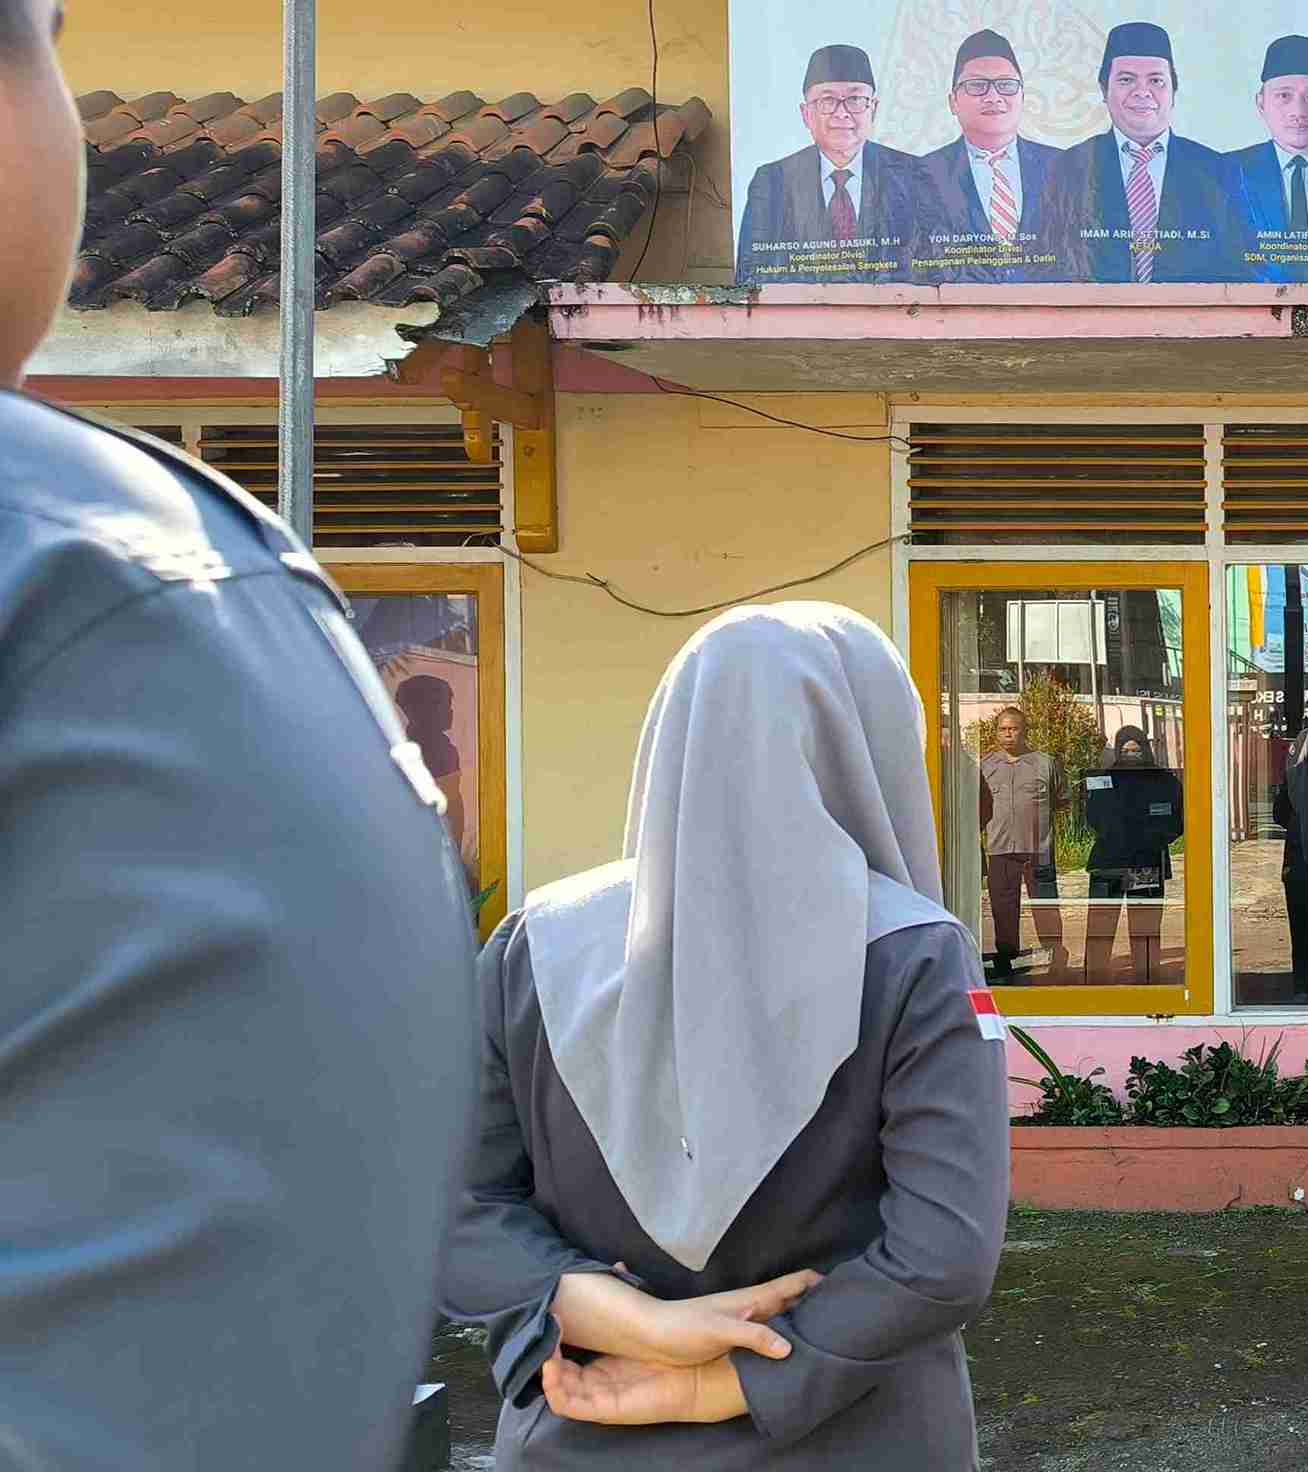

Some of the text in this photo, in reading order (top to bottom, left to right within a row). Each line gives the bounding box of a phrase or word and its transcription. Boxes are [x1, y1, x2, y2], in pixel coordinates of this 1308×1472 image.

[928, 234, 950, 243] YON
[952, 233, 1004, 243] DARYON
[1079, 230, 1110, 240] IMAM
[1256, 231, 1282, 240] AMIN
[752, 241, 800, 251] SUHARSO
[803, 240, 837, 250] AGUNG
